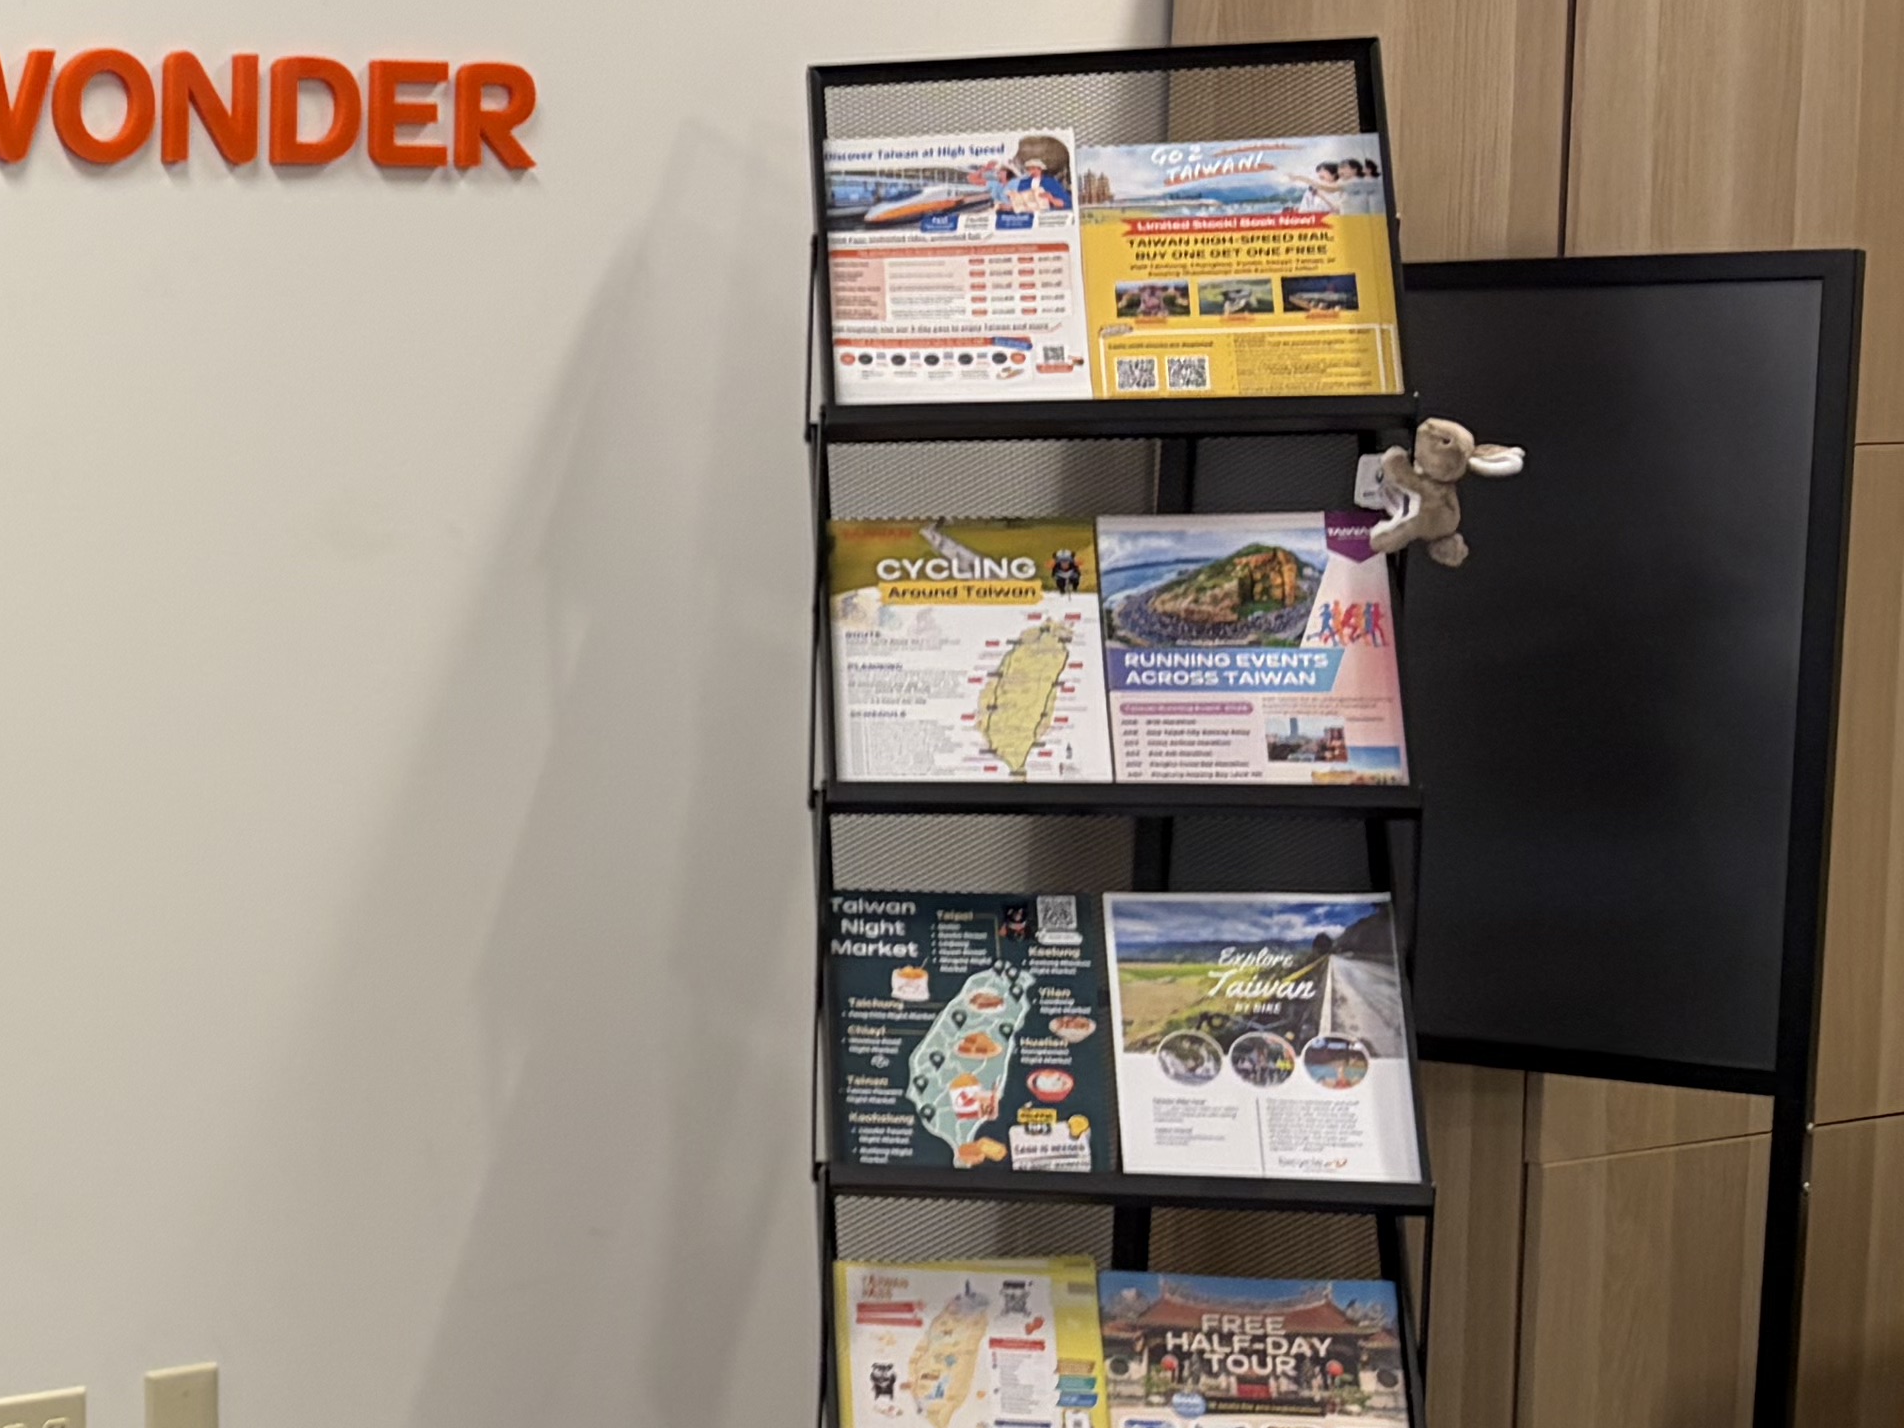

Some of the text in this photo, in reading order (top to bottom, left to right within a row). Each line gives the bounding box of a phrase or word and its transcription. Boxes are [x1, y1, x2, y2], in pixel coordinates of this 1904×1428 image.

[1188, 144, 1204, 163] 2
[1165, 152, 1264, 181] TAIWAN!
[1128, 236, 1190, 249] TAIWAN
[1136, 250, 1167, 261] BUY
[1172, 249, 1202, 260] ONE
[1247, 246, 1281, 258] ONE
[877, 556, 1036, 580] CYCLING
[889, 582, 1036, 599] Around Taiwan
[1125, 651, 1329, 669] RUNNING EVENTS
[1126, 669, 1316, 686] ACROSS TAIWAN
[830, 898, 916, 916] Taiwan
[840, 919, 906, 938] Night
[830, 939, 919, 958] Market
[1218, 946, 1293, 973] Explore
[1207, 969, 1317, 1001] Taiwan
[1202, 1314, 1285, 1335] FREE
[1166, 1331, 1333, 1357] HALF-DAY
[1204, 1353, 1297, 1376] TOUR
